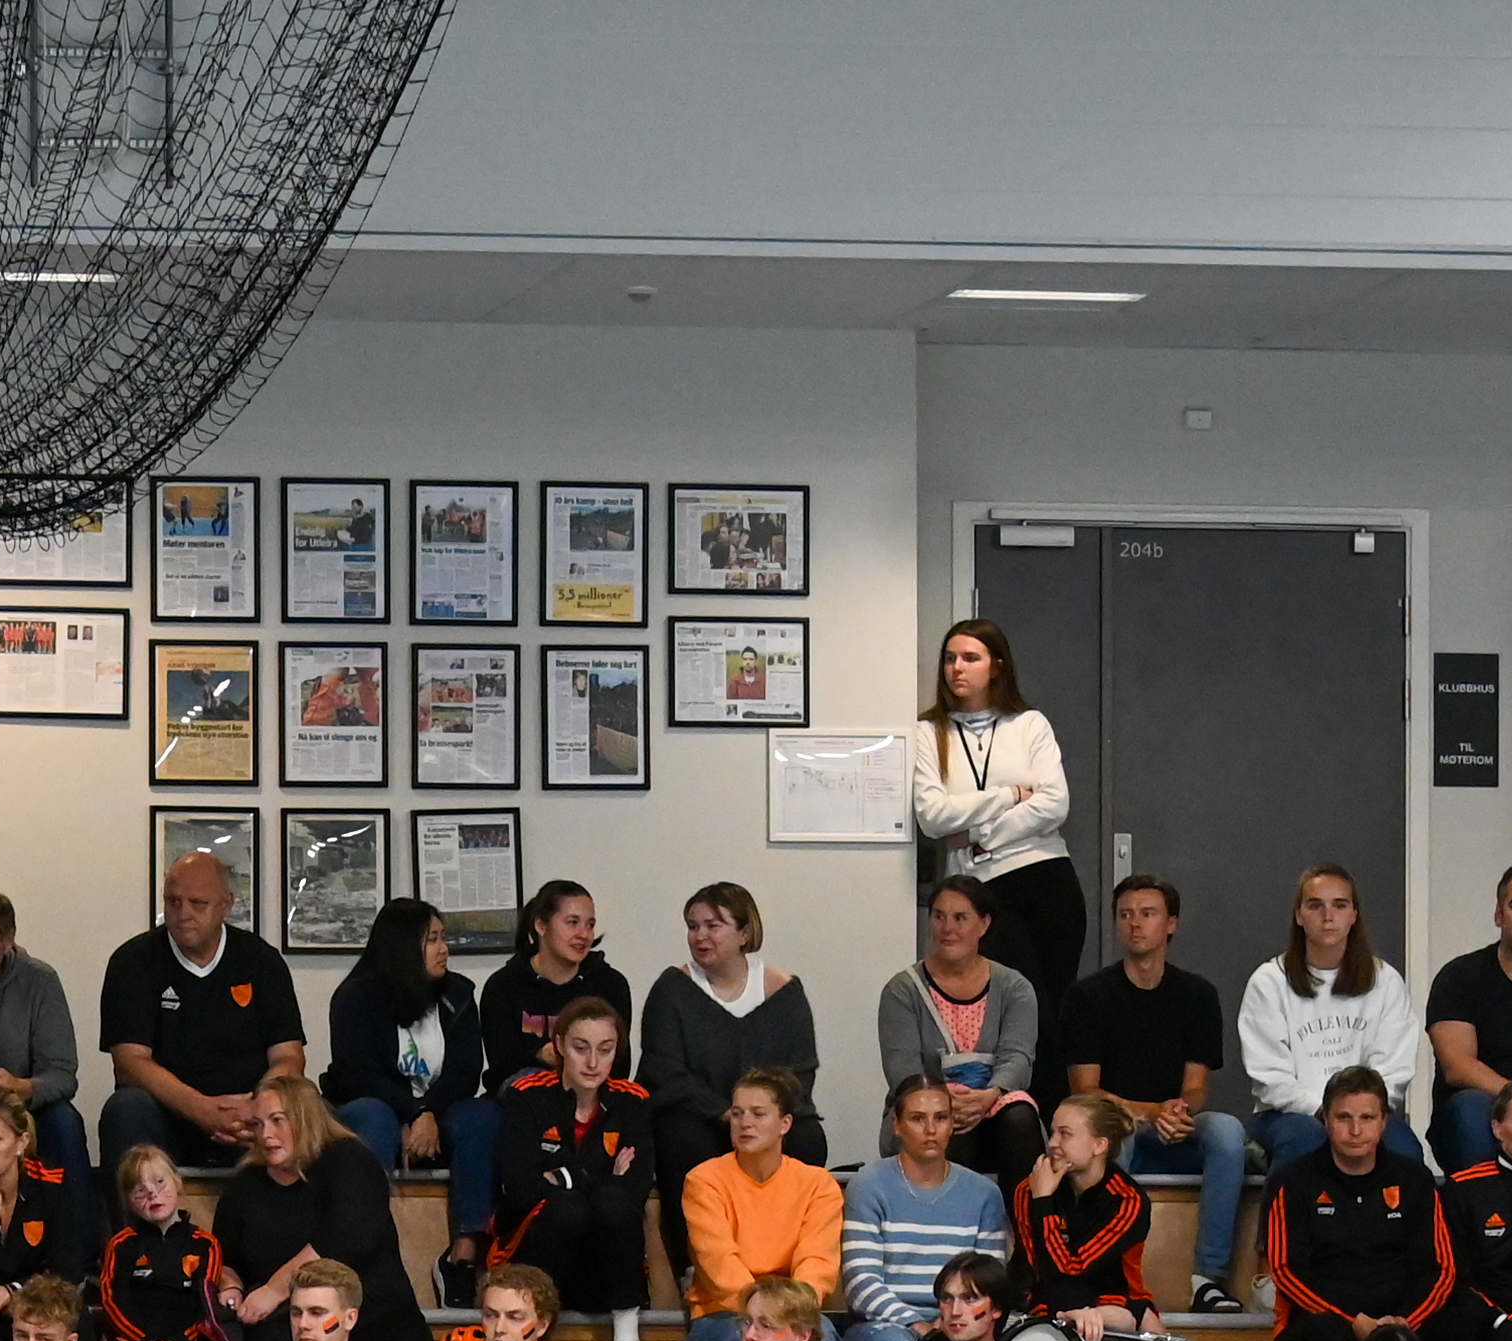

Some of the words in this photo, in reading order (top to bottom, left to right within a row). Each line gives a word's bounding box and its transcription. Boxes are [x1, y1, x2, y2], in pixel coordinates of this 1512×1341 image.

[1119, 541, 1164, 559] 204b
[1438, 683, 1496, 694] KLUBBHUS
[1459, 742, 1474, 753] TIL
